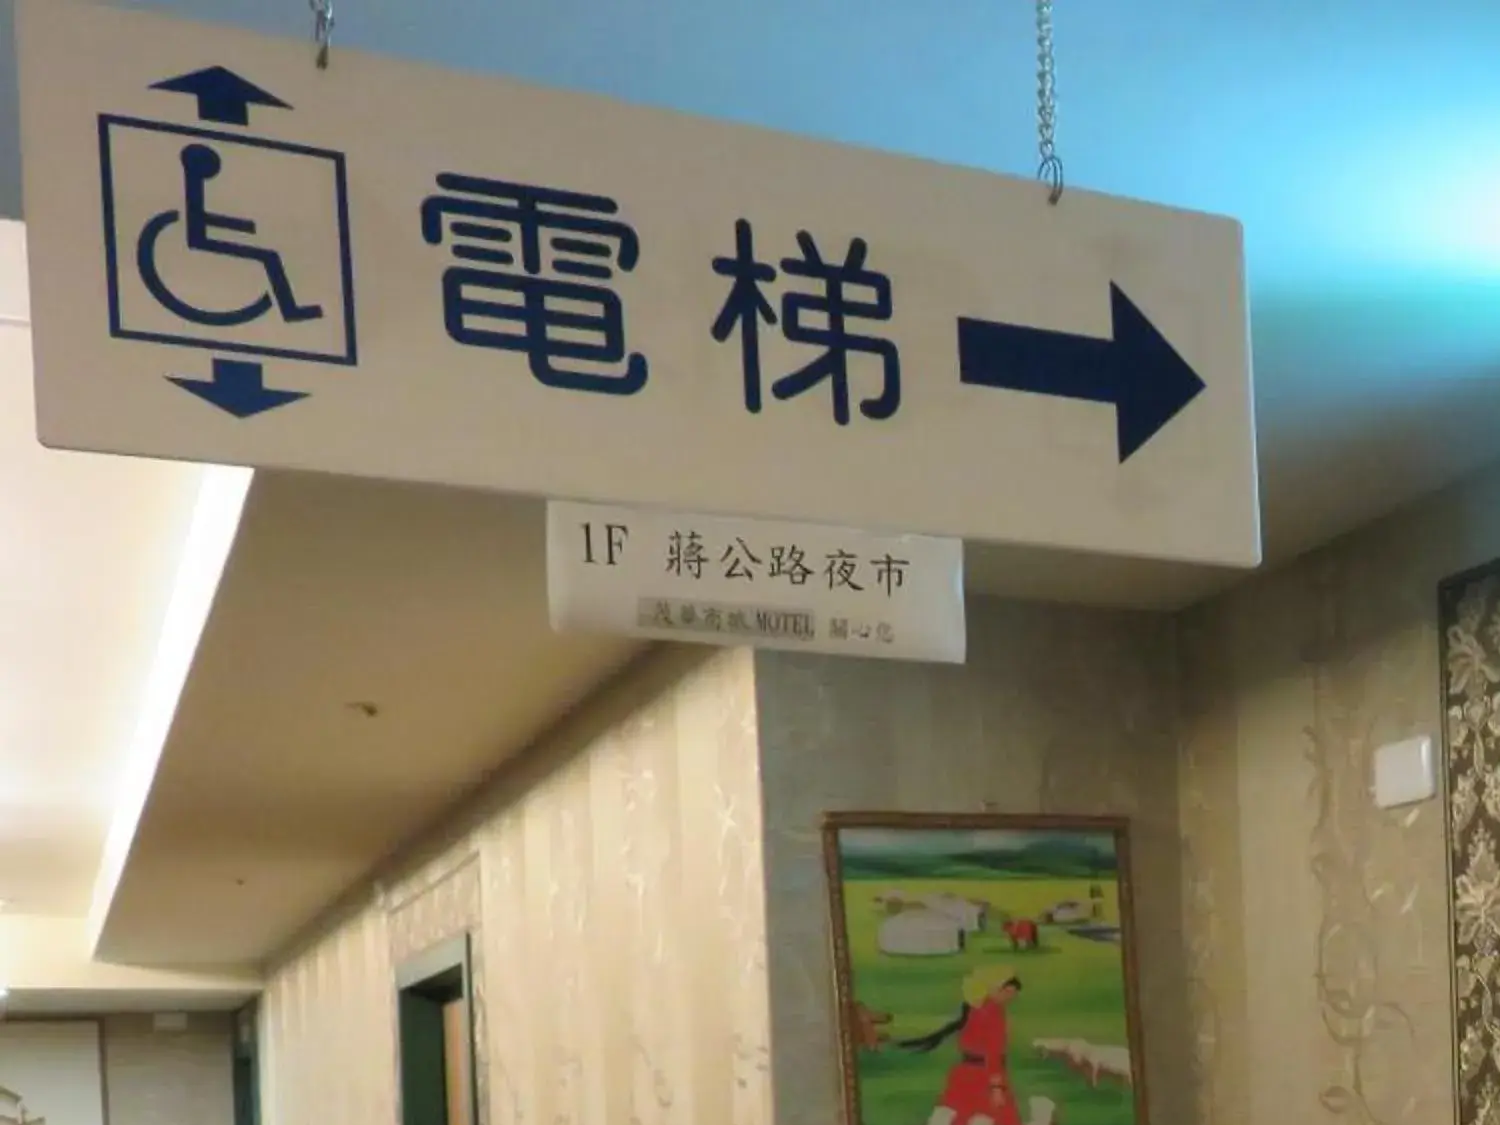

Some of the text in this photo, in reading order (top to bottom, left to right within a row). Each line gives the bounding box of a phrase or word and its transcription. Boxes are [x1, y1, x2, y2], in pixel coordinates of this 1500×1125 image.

[420, 171, 902, 427] 電梯
[580, 521, 911, 599] 1F 蔣公路夜市
